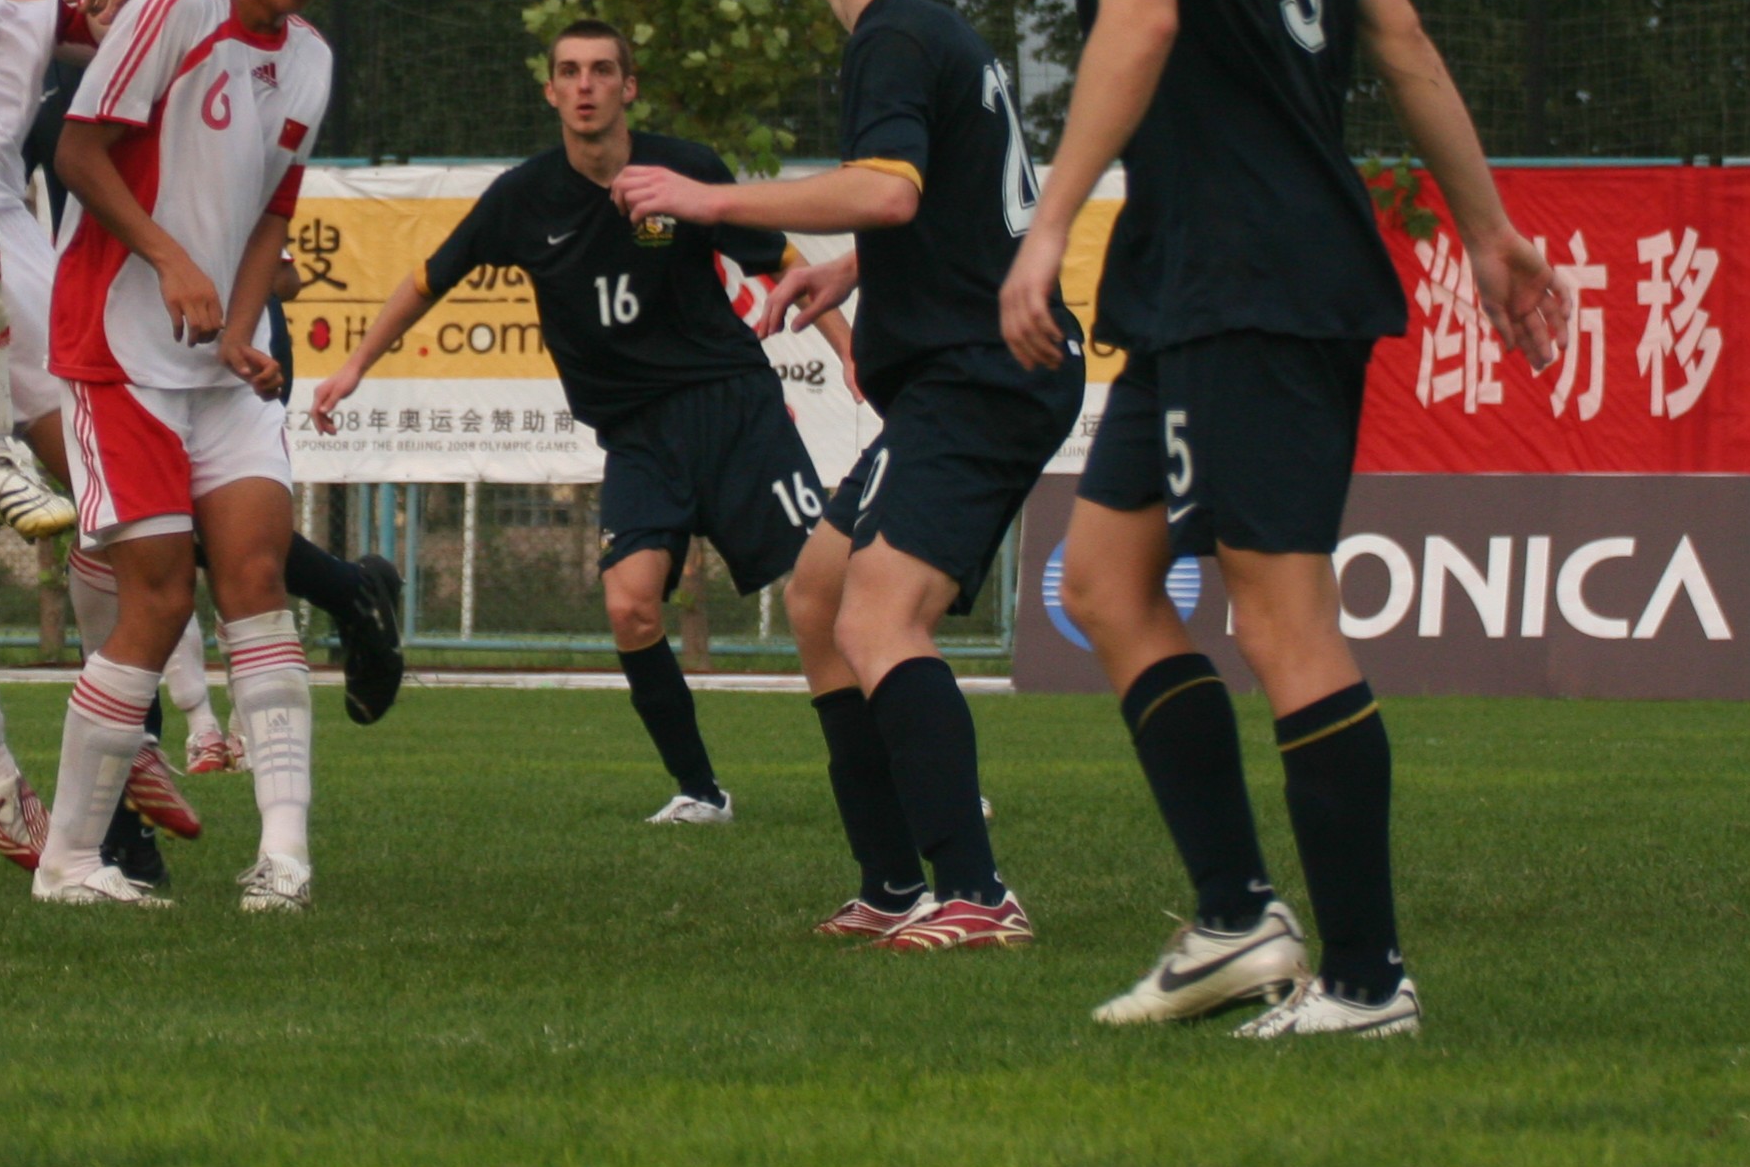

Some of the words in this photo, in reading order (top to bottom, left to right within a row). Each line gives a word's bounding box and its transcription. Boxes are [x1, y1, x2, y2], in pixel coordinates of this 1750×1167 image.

[200, 69, 232, 131] 6
[594, 273, 639, 326] 16
[285, 408, 576, 434] 208年奥运会赞助商
[295, 439, 349, 452] SPONSOR
[353, 439, 367, 452] OF
[372, 439, 392, 452] THE
[397, 439, 442, 452] BEIJING
[479, 440, 532, 452] OLYMPIC
[535, 440, 578, 452] GAMES
[1164, 410, 1193, 497] 5
[772, 471, 823, 527] 16
[1226, 533, 1733, 640] ONICA
